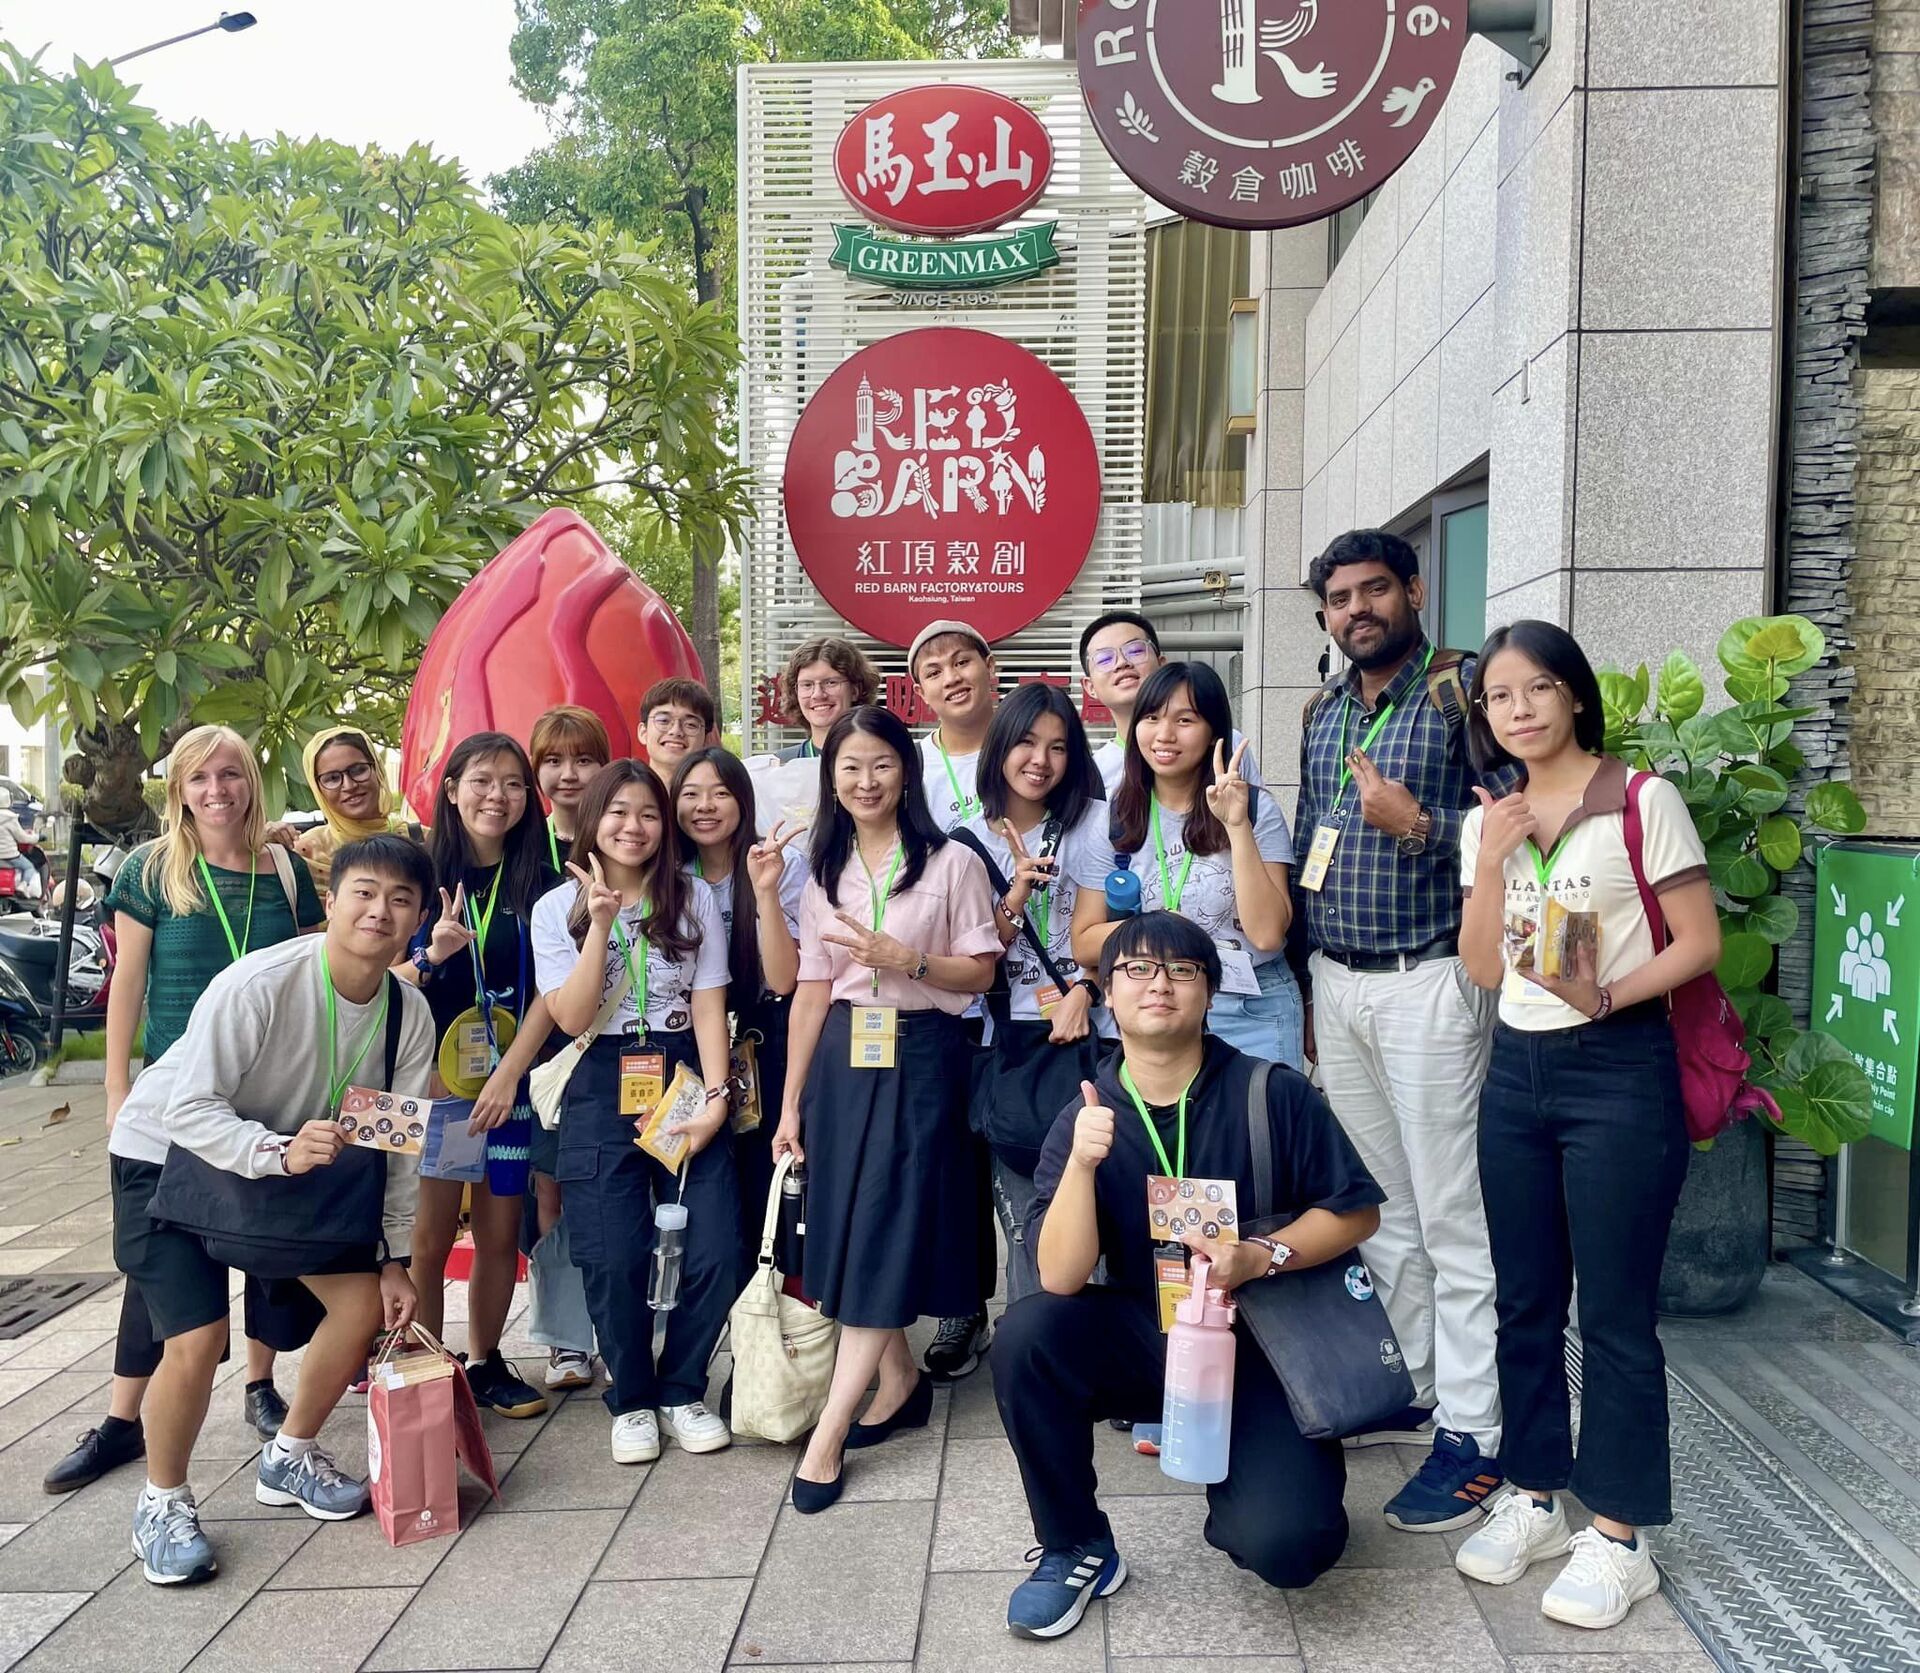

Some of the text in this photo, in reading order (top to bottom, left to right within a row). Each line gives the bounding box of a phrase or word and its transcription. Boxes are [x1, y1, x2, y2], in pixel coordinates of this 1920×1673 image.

[857, 111, 1033, 206] 馬玉山
[1177, 138, 1367, 203] 穀倉咖啡
[858, 241, 1030, 275] GREENMAX
[890, 291, 951, 307] SINCE
[851, 370, 1021, 450] RED
[831, 444, 1047, 519] BARN
[856, 540, 1025, 575] 紅頂穀創
[855, 582, 1024, 593] RED BARN FACTORY&TOURS
